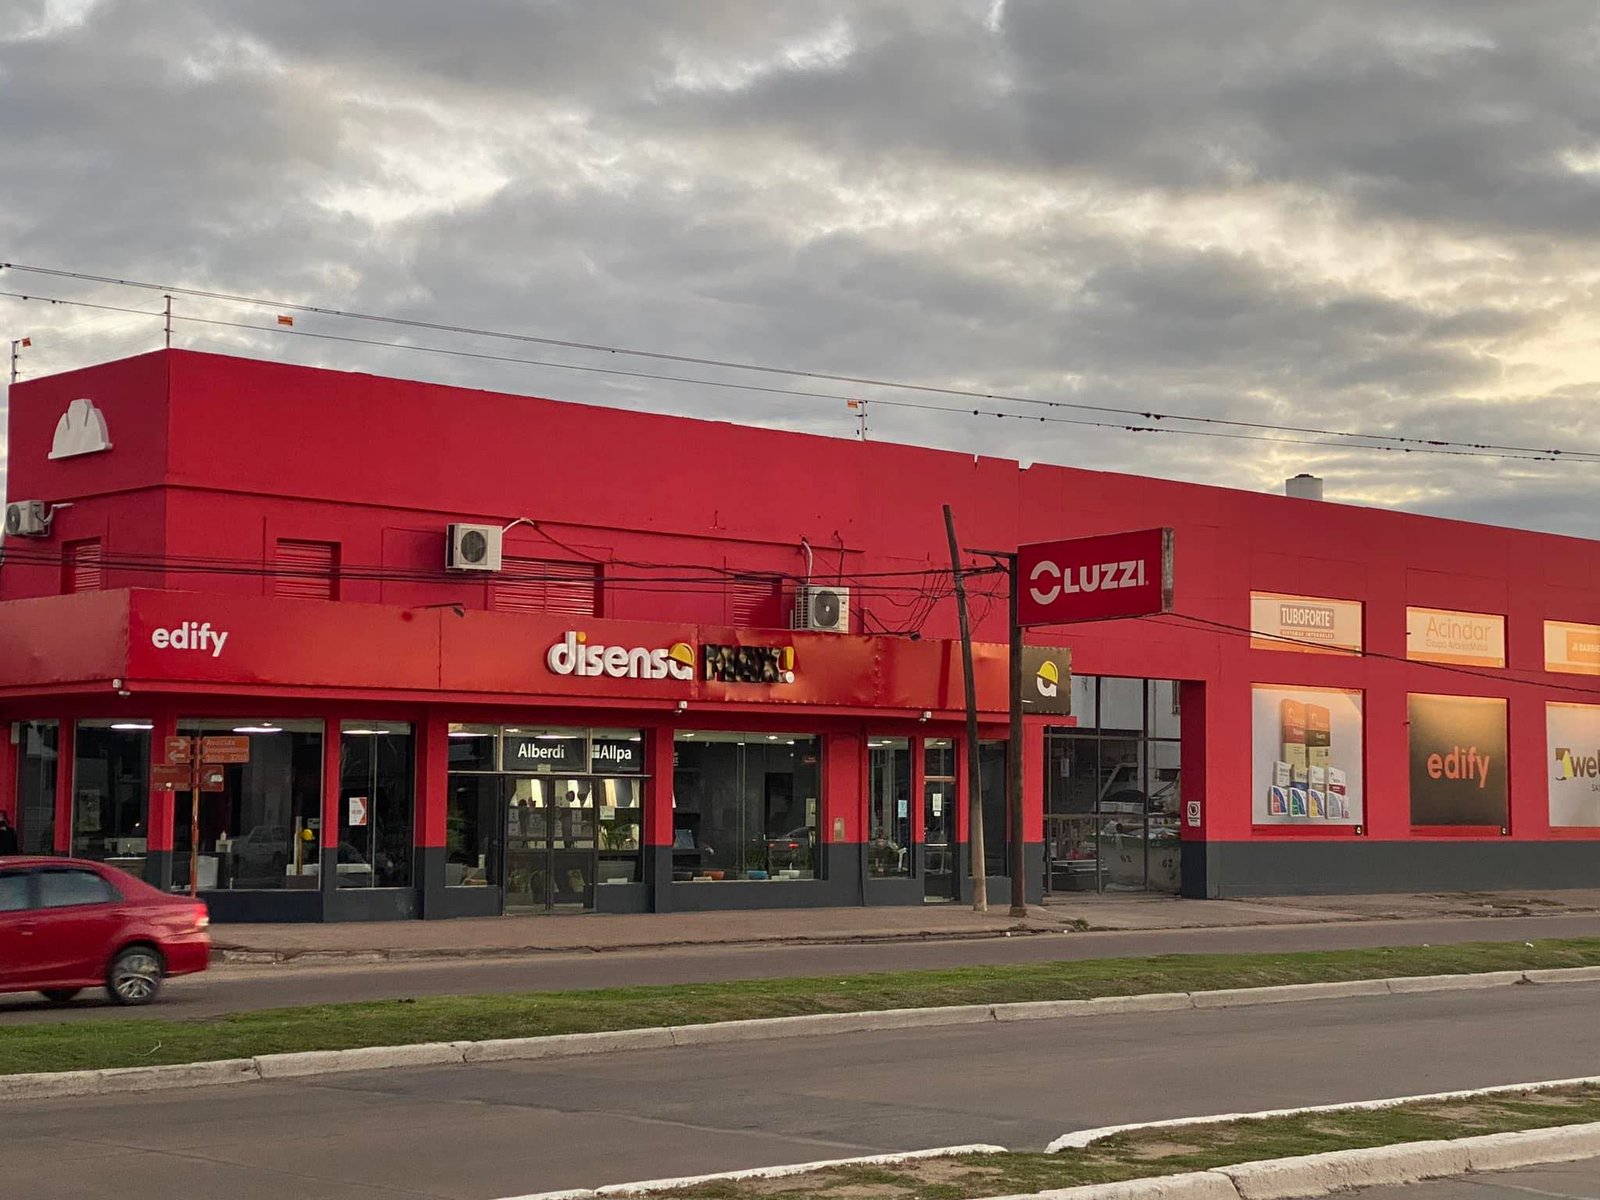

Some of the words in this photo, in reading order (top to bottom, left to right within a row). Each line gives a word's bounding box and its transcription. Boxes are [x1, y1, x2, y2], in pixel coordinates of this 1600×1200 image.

[1064, 559, 1145, 594] LUZZI
[1281, 607, 1330, 627] TUBOFORTE
[1425, 616, 1491, 641] Acindar
[152, 621, 229, 657] edify
[547, 631, 694, 681] disensa
[518, 743, 565, 759] Alberdi
[600, 744, 632, 763] Allpa
[1427, 746, 1490, 789] edify
